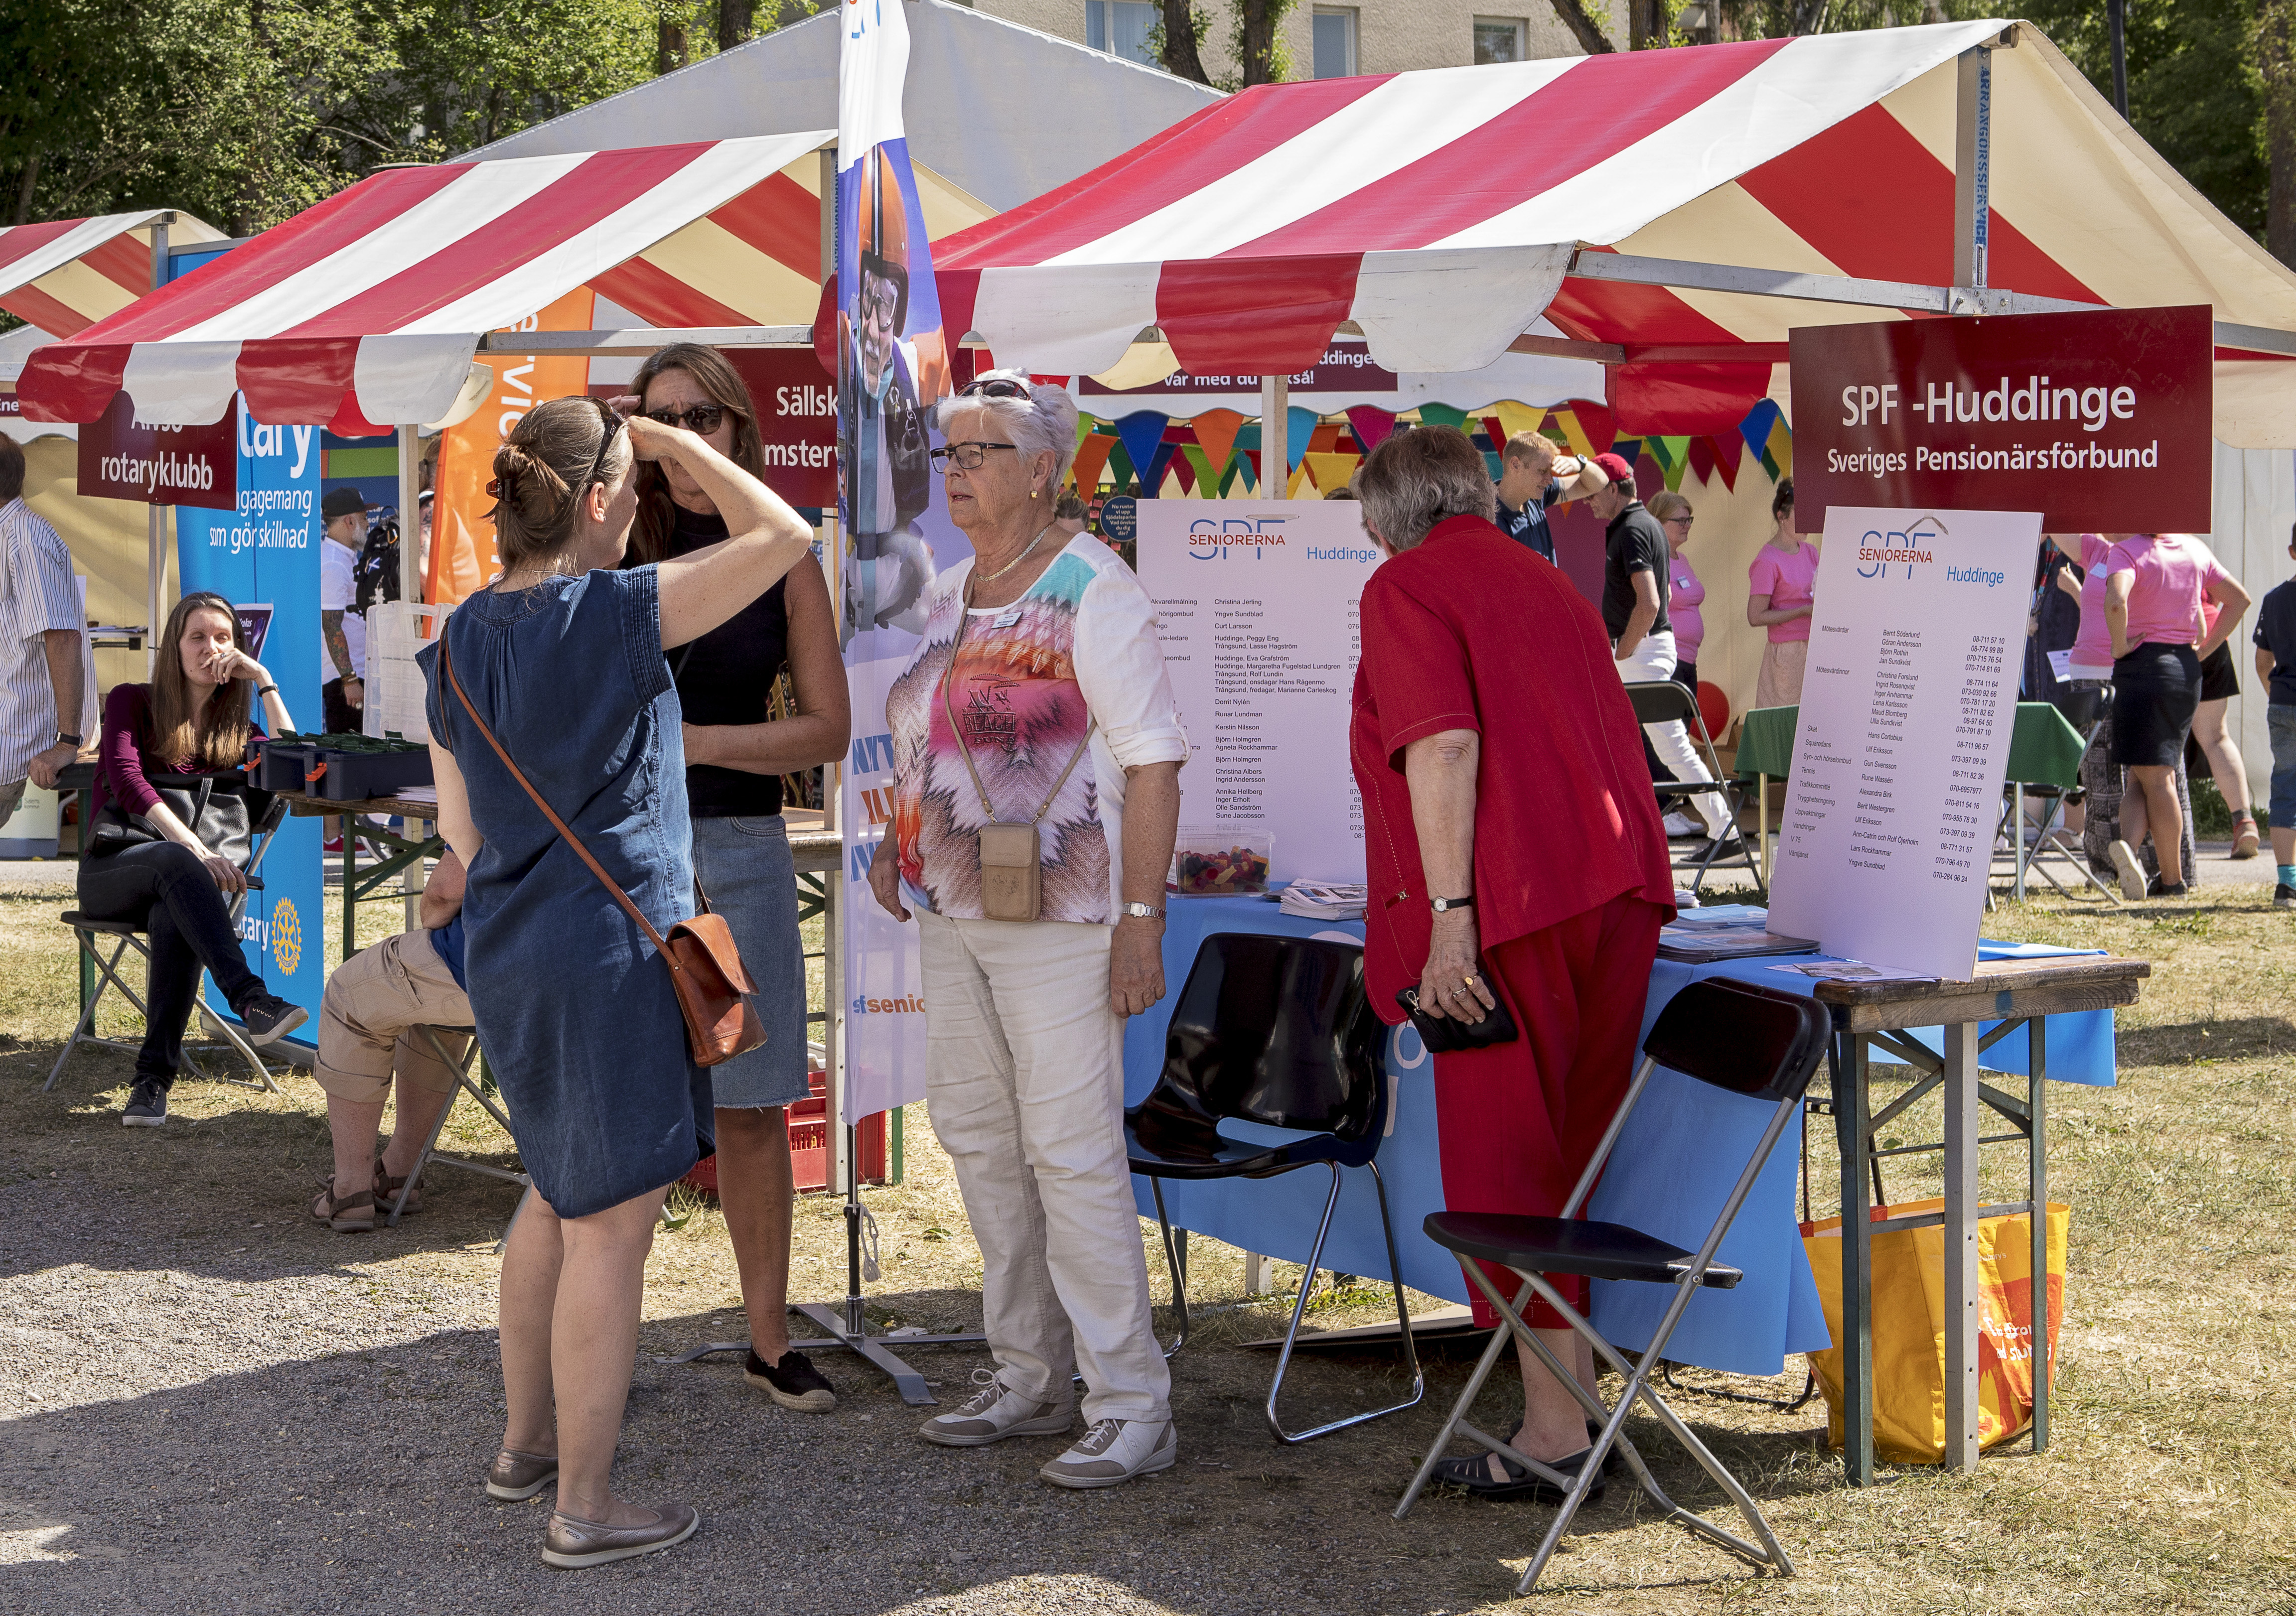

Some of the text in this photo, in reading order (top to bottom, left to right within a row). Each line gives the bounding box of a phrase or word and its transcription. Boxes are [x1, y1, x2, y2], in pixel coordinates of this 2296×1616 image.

[1842, 376, 2136, 431] SPF -Huddinge
[1828, 440, 2158, 478] Sveriges Pensionärsförbund
[101, 450, 213, 495] rotaryklubb
[210, 526, 227, 547] som
[231, 523, 257, 554] gör
[259, 520, 309, 548] skillnad
[1189, 534, 1286, 546] SENIORERNA
[1306, 546, 1377, 563] Huddinge
[1858, 547, 1933, 564] SENIORERNA
[1947, 566, 2005, 587] Huddinge
[1896, 630, 1921, 639] Söderlund
[1972, 635, 1990, 644] 08-711
[1896, 639, 1922, 648] Andersson
[1970, 645, 1989, 653] 08-774
[1888, 657, 1911, 666] Sundkvist
[1966, 654, 1987, 663] 070-715
[1988, 655, 1995, 664] 76
[1965, 663, 1986, 672] 070-714
[1876, 671, 1919, 681] Christina Forslund
[1875, 680, 1889, 689] Ingrid
[1873, 689, 1886, 698] Inger
[1885, 709, 1908, 720] Blomberg
[964, 714, 1015, 732] BEACH
[1879, 718, 1903, 727] Sundkvist
[1807, 724, 1818, 733] Skat
[1880, 732, 1903, 742] Cortobius
[1805, 738, 1832, 748] Squaredans
[1874, 760, 1897, 770] Svensson
[1801, 766, 1816, 775] Tennis
[1793, 821, 1817, 832] Vandringar
